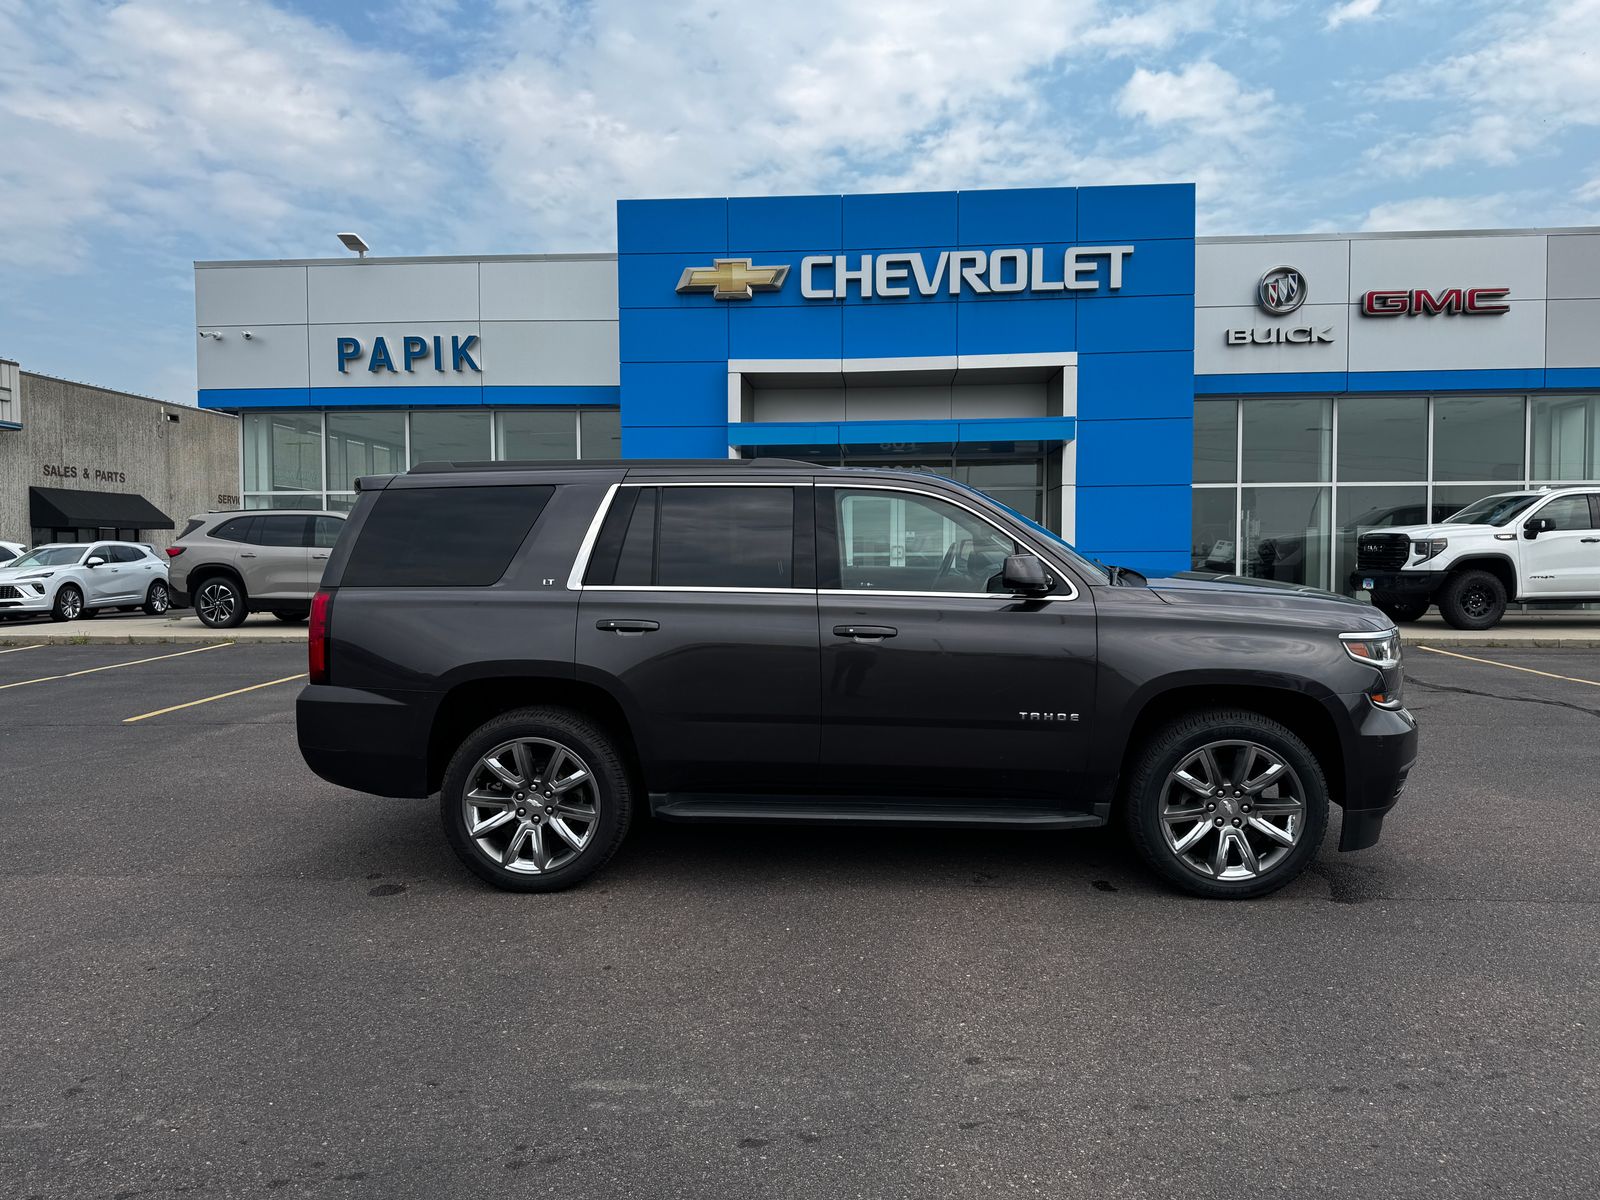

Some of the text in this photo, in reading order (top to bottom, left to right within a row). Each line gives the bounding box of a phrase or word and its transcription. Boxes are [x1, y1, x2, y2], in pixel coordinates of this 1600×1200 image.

[800, 245, 1135, 299] CHEVROLET
[1363, 287, 1511, 317] GMC
[1226, 326, 1335, 346] BUICK
[336, 335, 482, 373] PAPIK
[43, 464, 126, 483] SALES & PARTS
[1019, 712, 1079, 721] TAHOE
